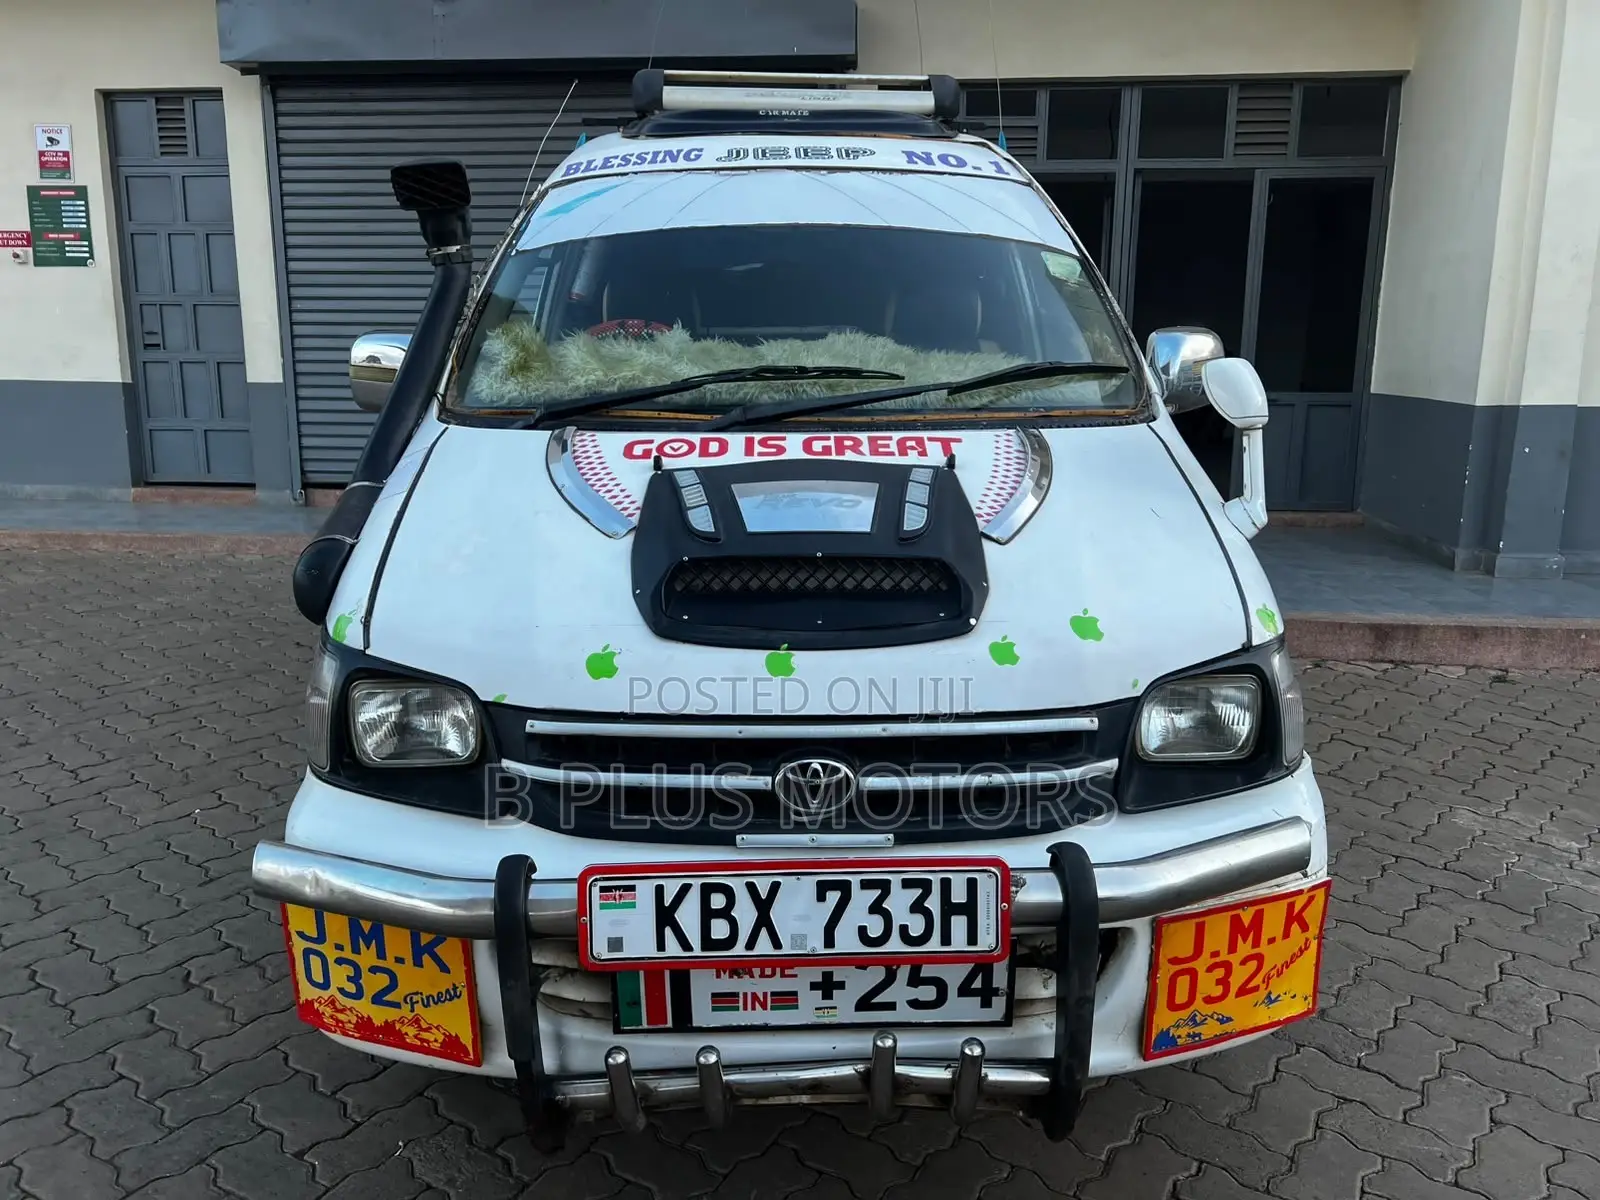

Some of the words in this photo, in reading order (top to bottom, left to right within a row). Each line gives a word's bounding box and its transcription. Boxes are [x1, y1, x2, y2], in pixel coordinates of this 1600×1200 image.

[560, 148, 704, 178] BLESSING
[716, 146, 876, 162] JEEP
[622, 437, 729, 460] GOD
[744, 435, 787, 457] IS
[802, 435, 963, 458] GREAT
[294, 908, 451, 975] J.M.K
[654, 881, 784, 953] KBX
[815, 876, 979, 950] 733H
[1167, 894, 1317, 966] J.M.K
[301, 946, 402, 1010] 032
[403, 984, 463, 1012] Finest
[714, 967, 799, 980] MADE
[742, 991, 769, 1012] IN
[809, 964, 1000, 1012] +254
[1165, 951, 1266, 1013] 032
[1261, 936, 1312, 991] Finest
